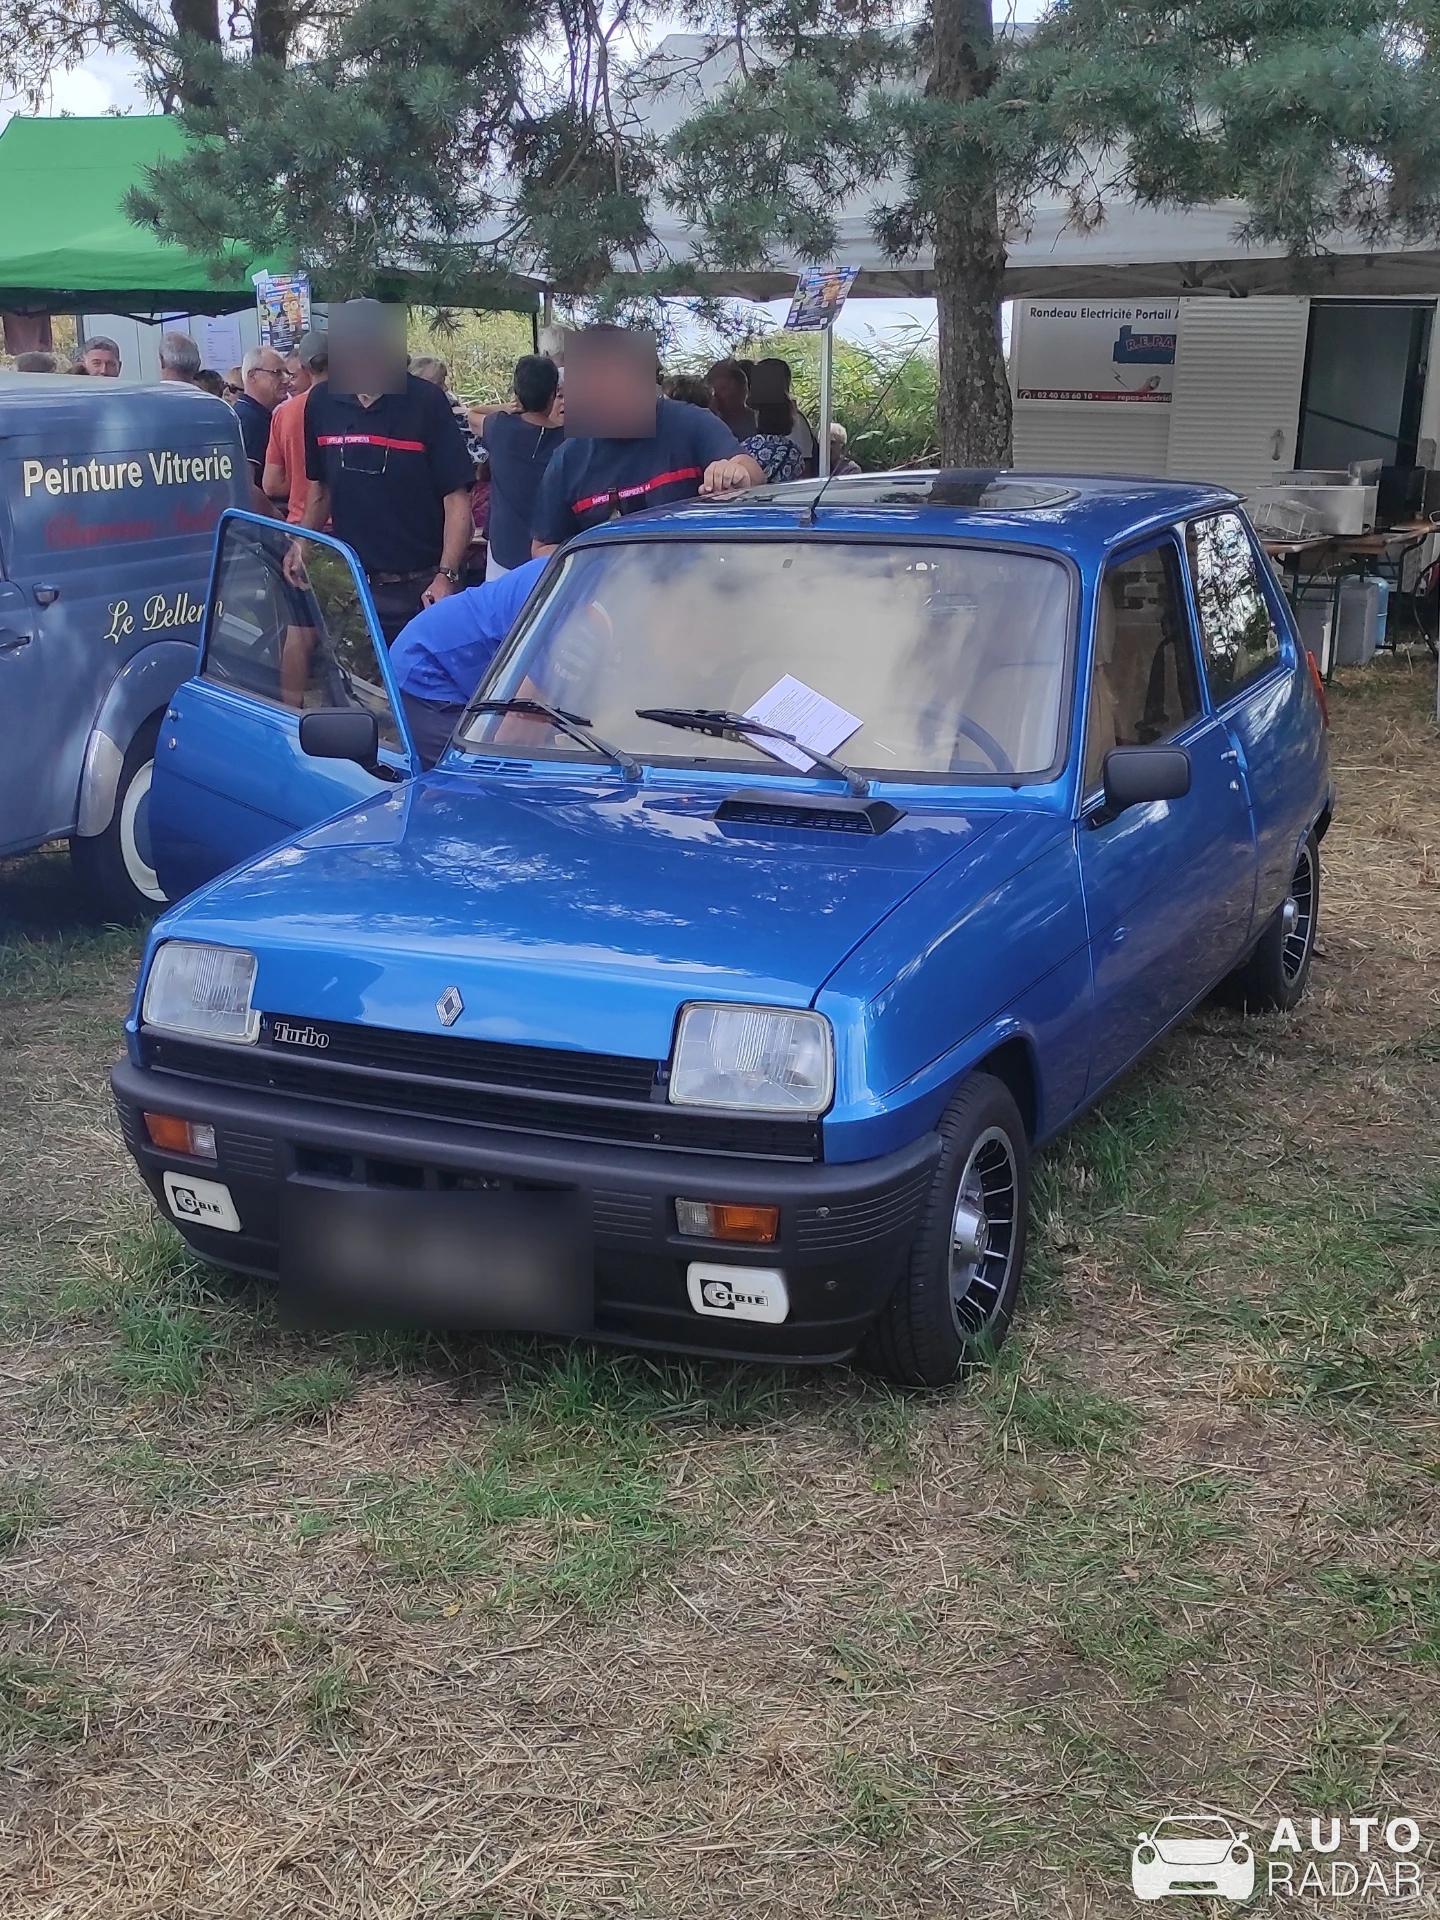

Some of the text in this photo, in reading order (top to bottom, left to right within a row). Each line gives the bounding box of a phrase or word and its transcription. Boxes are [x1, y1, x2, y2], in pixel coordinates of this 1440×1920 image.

[1030, 307, 1077, 319] Rondeau
[1080, 307, 1132, 320] Electricité
[1135, 308, 1171, 320] Portail
[1037, 391, 1047, 399] 02
[1049, 391, 1059, 399] 40
[1071, 392, 1081, 400] 60
[1083, 392, 1093, 400] 10
[23, 448, 233, 497] Peinture Vitrerie
[103, 592, 225, 645] Le Pellern
[274, 1021, 330, 1049] Turbo
[184, 1197, 222, 1214] CIBIE
[715, 1291, 766, 1305] CIBIE
